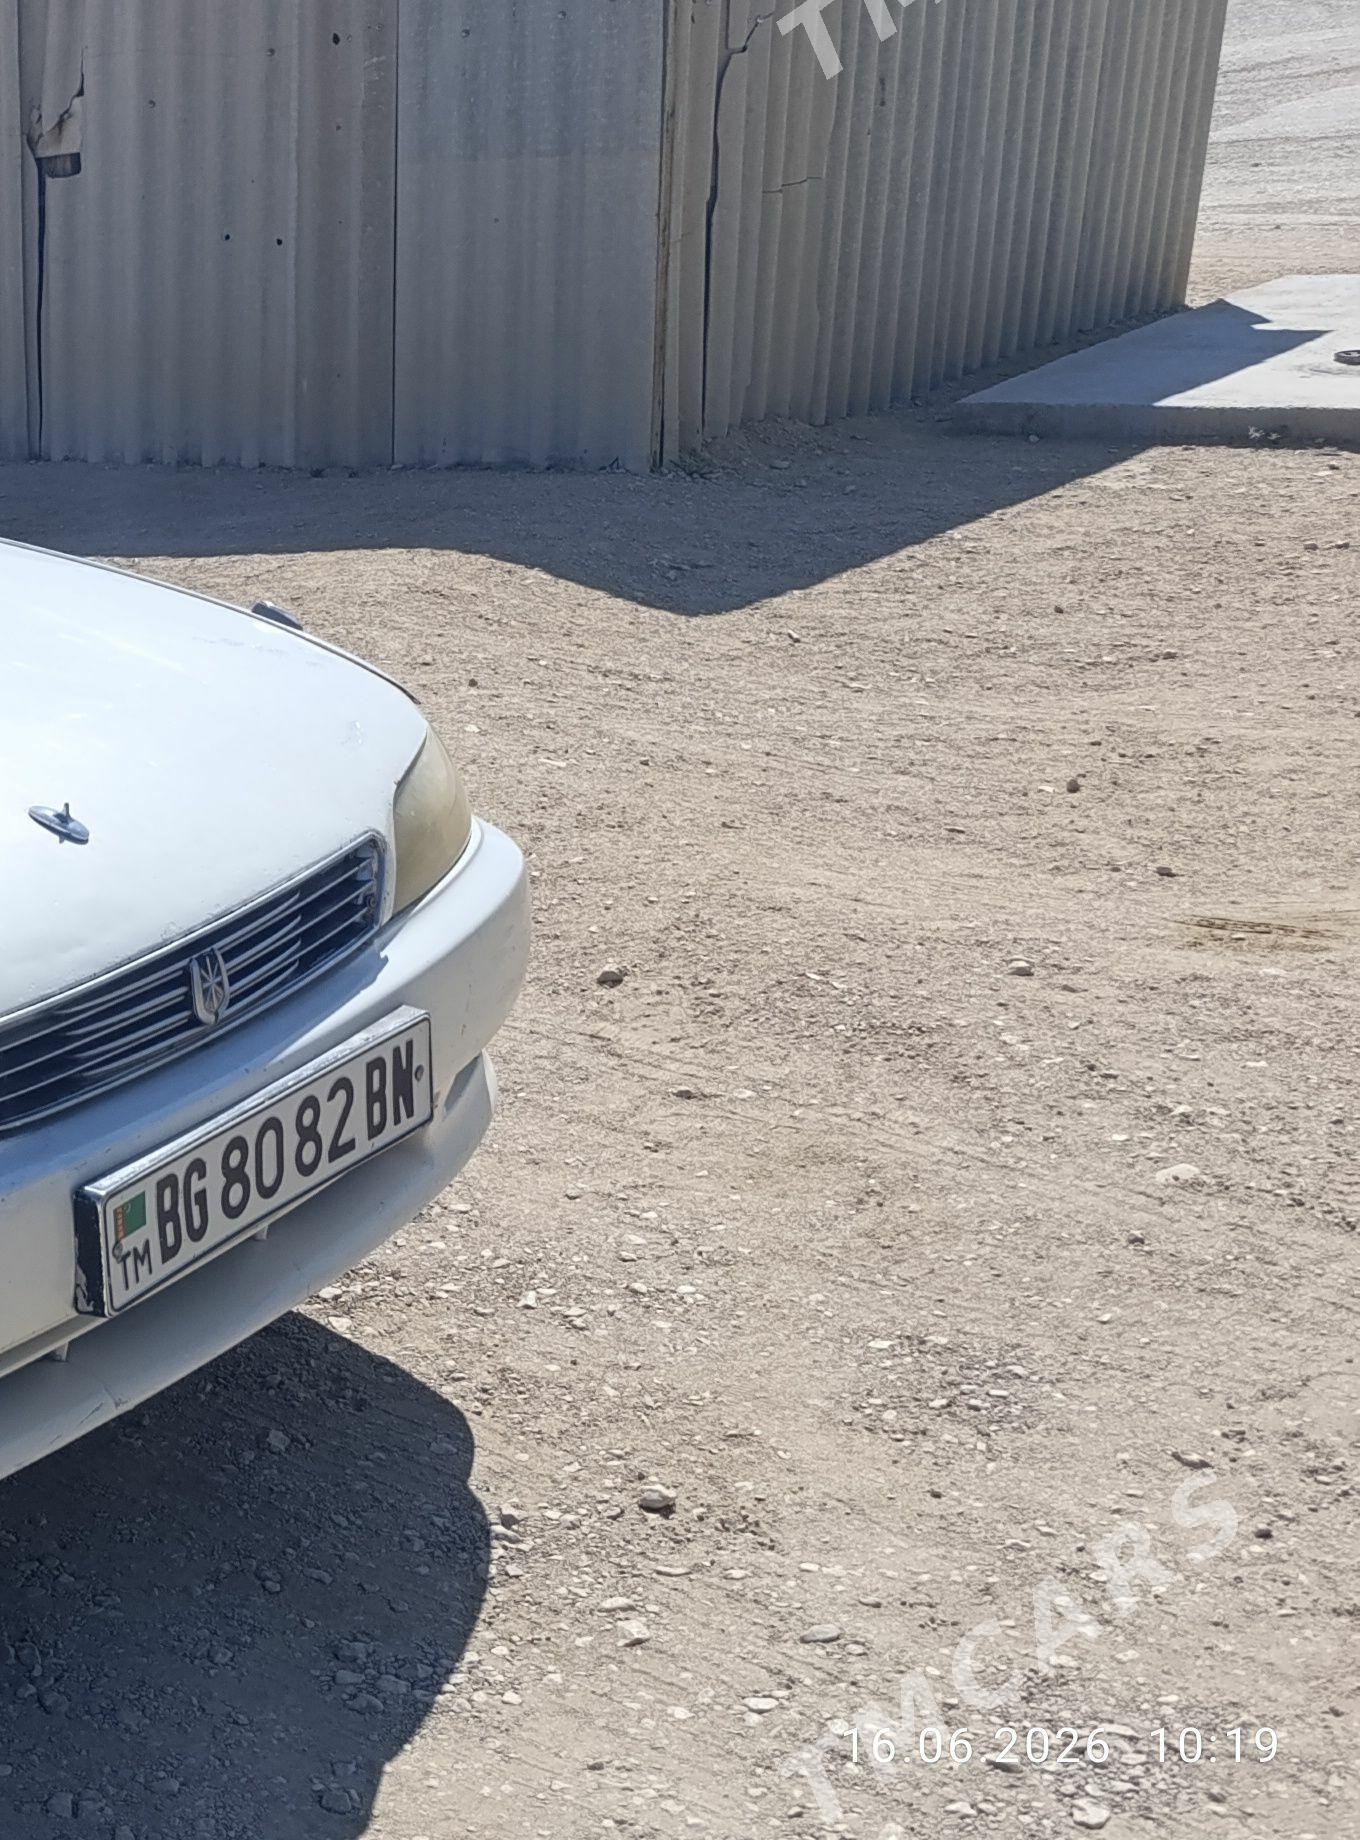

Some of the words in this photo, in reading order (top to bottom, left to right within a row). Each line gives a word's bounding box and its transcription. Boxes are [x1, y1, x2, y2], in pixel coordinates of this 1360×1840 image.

[156, 1157, 209, 1264] BG
[366, 1039, 415, 1141] BN
[118, 1238, 153, 1291] TM
